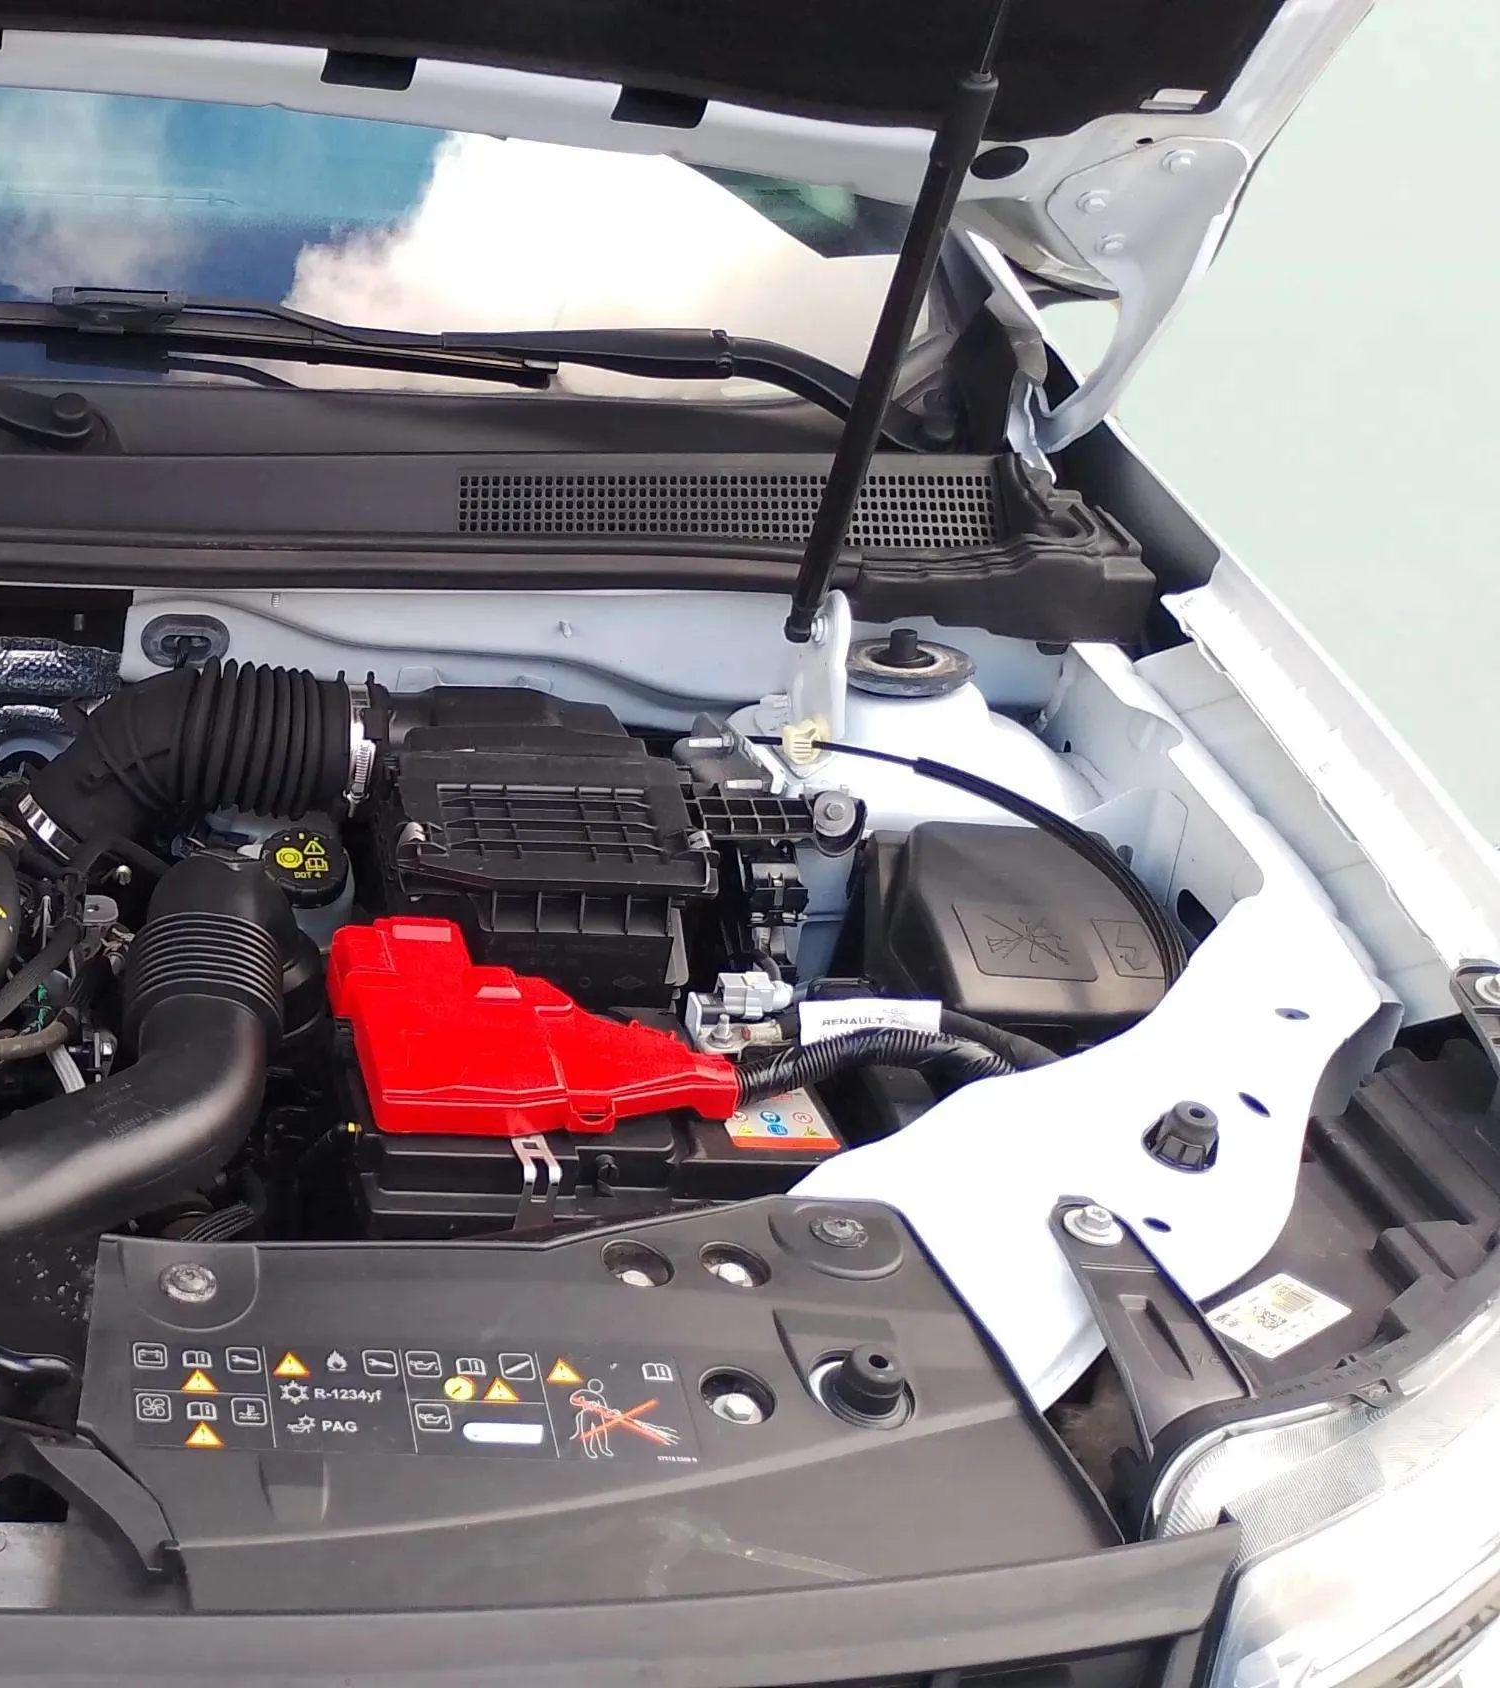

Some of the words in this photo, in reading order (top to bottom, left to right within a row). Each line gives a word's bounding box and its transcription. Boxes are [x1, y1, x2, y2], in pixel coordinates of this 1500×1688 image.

[294, 871, 312, 879] DOT
[314, 871, 322, 879] 4
[821, 1016, 885, 1027] RENAULT
[314, 1387, 382, 1404] R-1234yf
[321, 1420, 358, 1433] PAG
